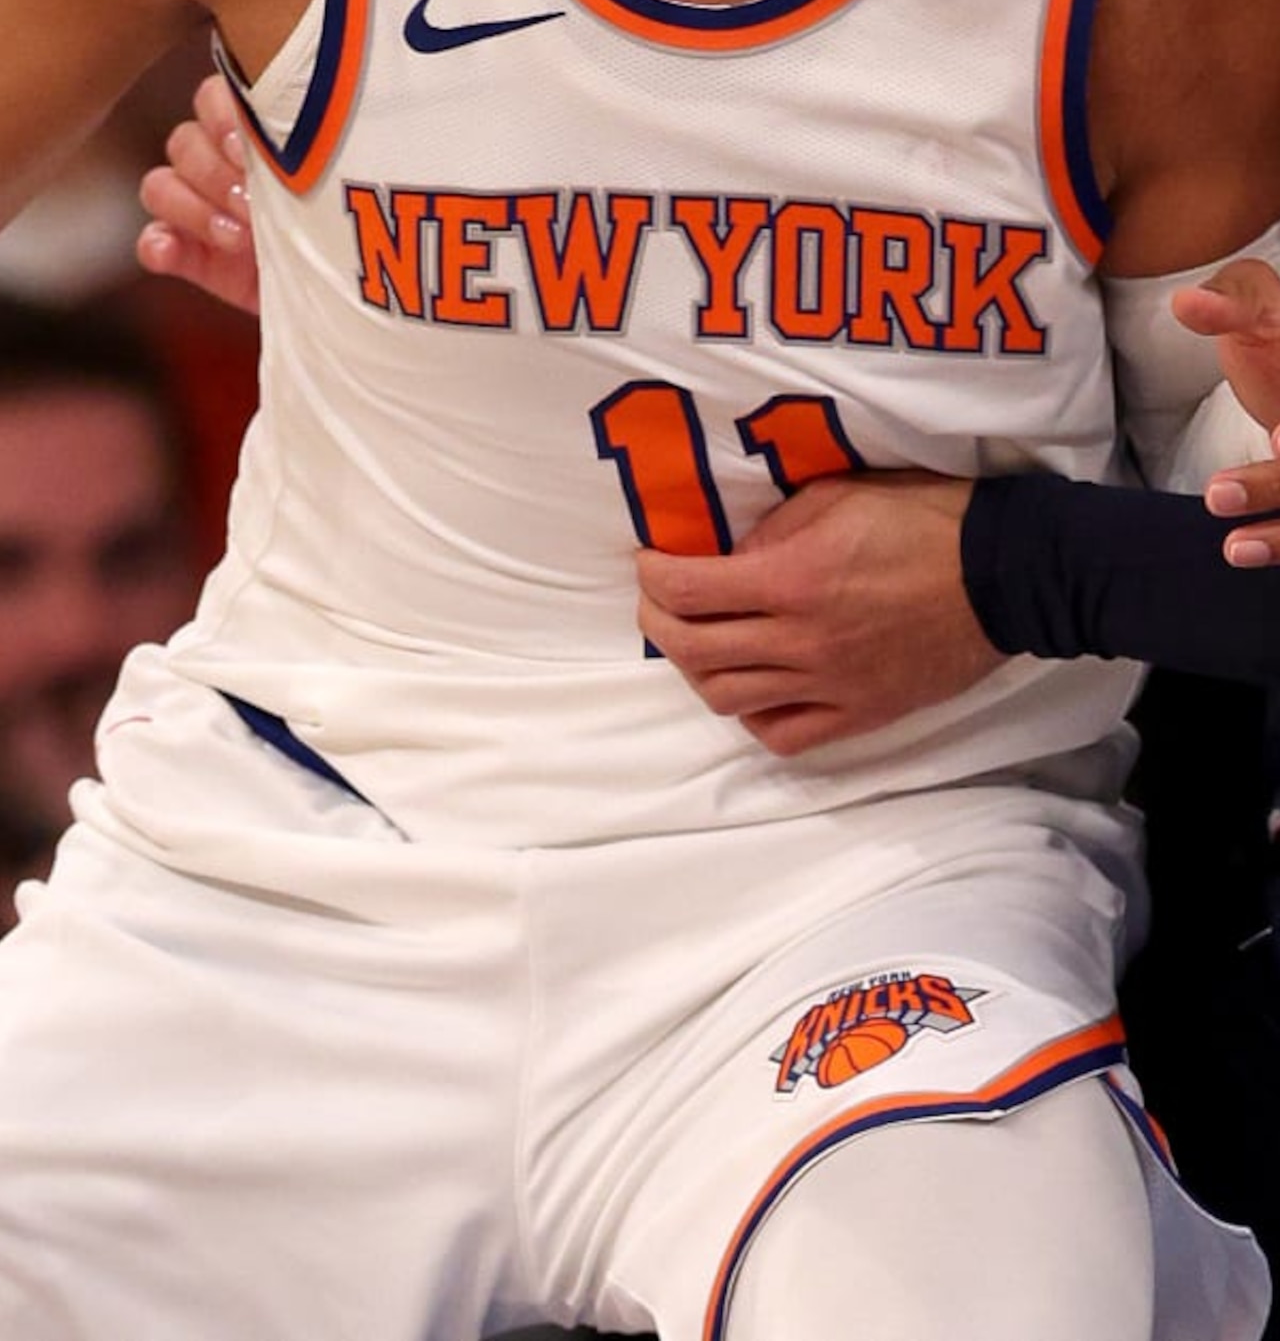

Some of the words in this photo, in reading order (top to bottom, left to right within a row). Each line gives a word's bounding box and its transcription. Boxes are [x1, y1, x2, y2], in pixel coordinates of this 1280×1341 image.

[343, 180, 654, 337] NEW
[668, 196, 1054, 361] YORK
[775, 973, 975, 1093] KNICKS
